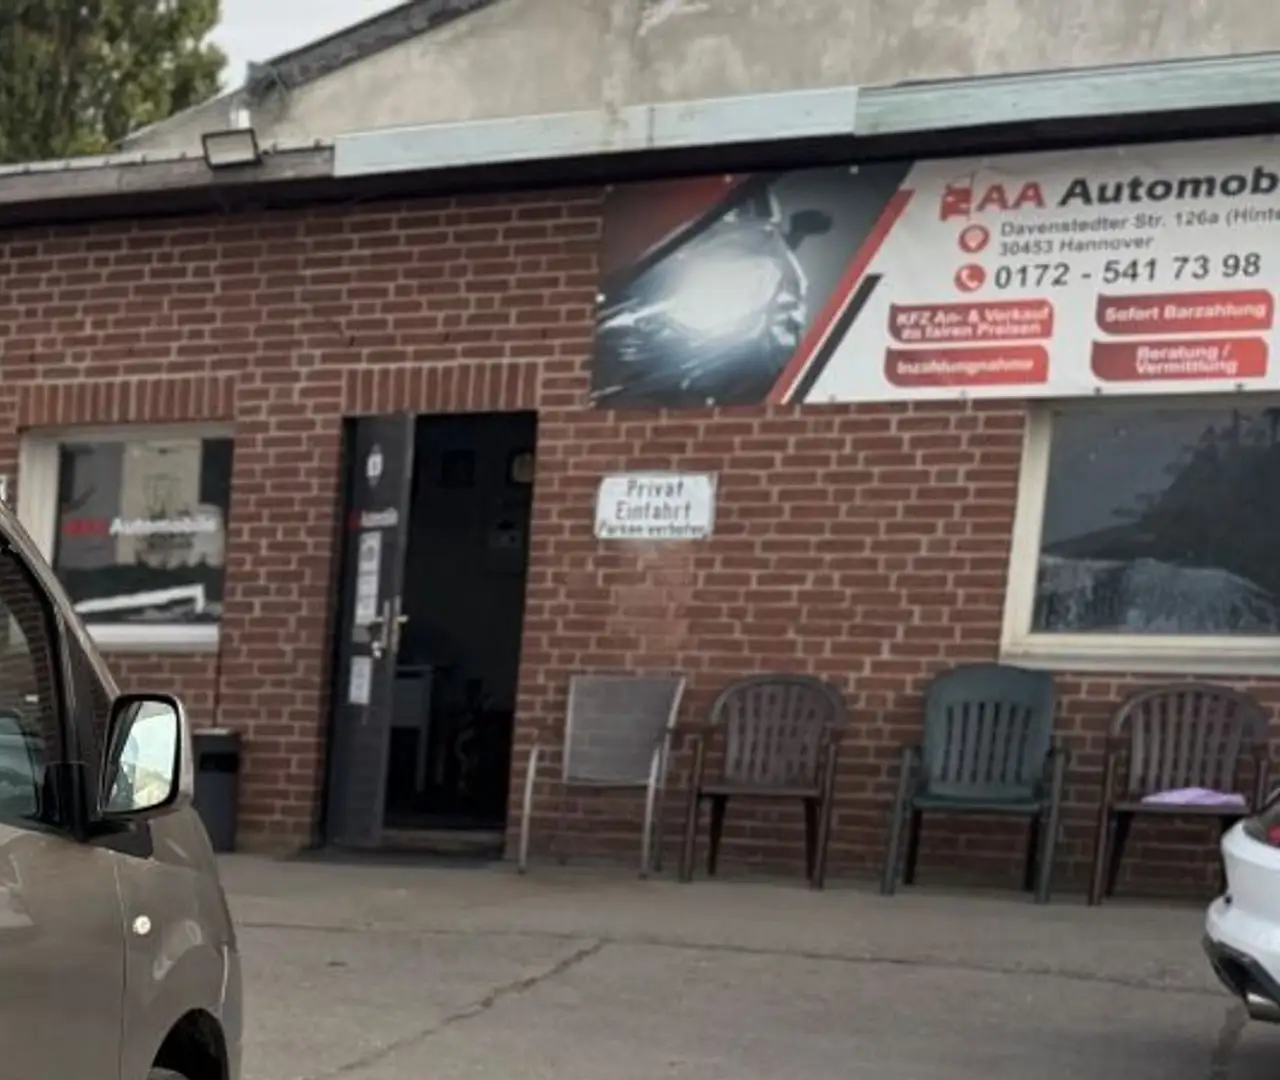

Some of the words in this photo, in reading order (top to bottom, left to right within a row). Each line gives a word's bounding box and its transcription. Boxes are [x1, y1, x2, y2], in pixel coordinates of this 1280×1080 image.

[976, 180, 1048, 212] AA
[1056, 165, 1280, 207] Automob
[1000, 214, 1128, 237] Davenstedter
[1134, 212, 1167, 230] Str.
[1175, 209, 1220, 229] 126a
[999, 238, 1053, 257] 30453
[1059, 234, 1154, 253] Hannover
[994, 262, 1070, 290] 0172
[1102, 257, 1158, 284] 541
[1172, 254, 1210, 280] 73
[1221, 251, 1262, 278] 98
[896, 311, 932, 326] KFZ
[984, 306, 1050, 322] Verkauf
[1105, 306, 1159, 322] Sofort
[1163, 302, 1267, 321] Barzahlung
[925, 325, 973, 338] fairen
[977, 322, 1042, 337] Preisen
[1136, 344, 1219, 362] Beratung
[1135, 359, 1238, 376] Vermittlung
[627, 478, 684, 497] Privat
[615, 500, 692, 520] Einfahrt
